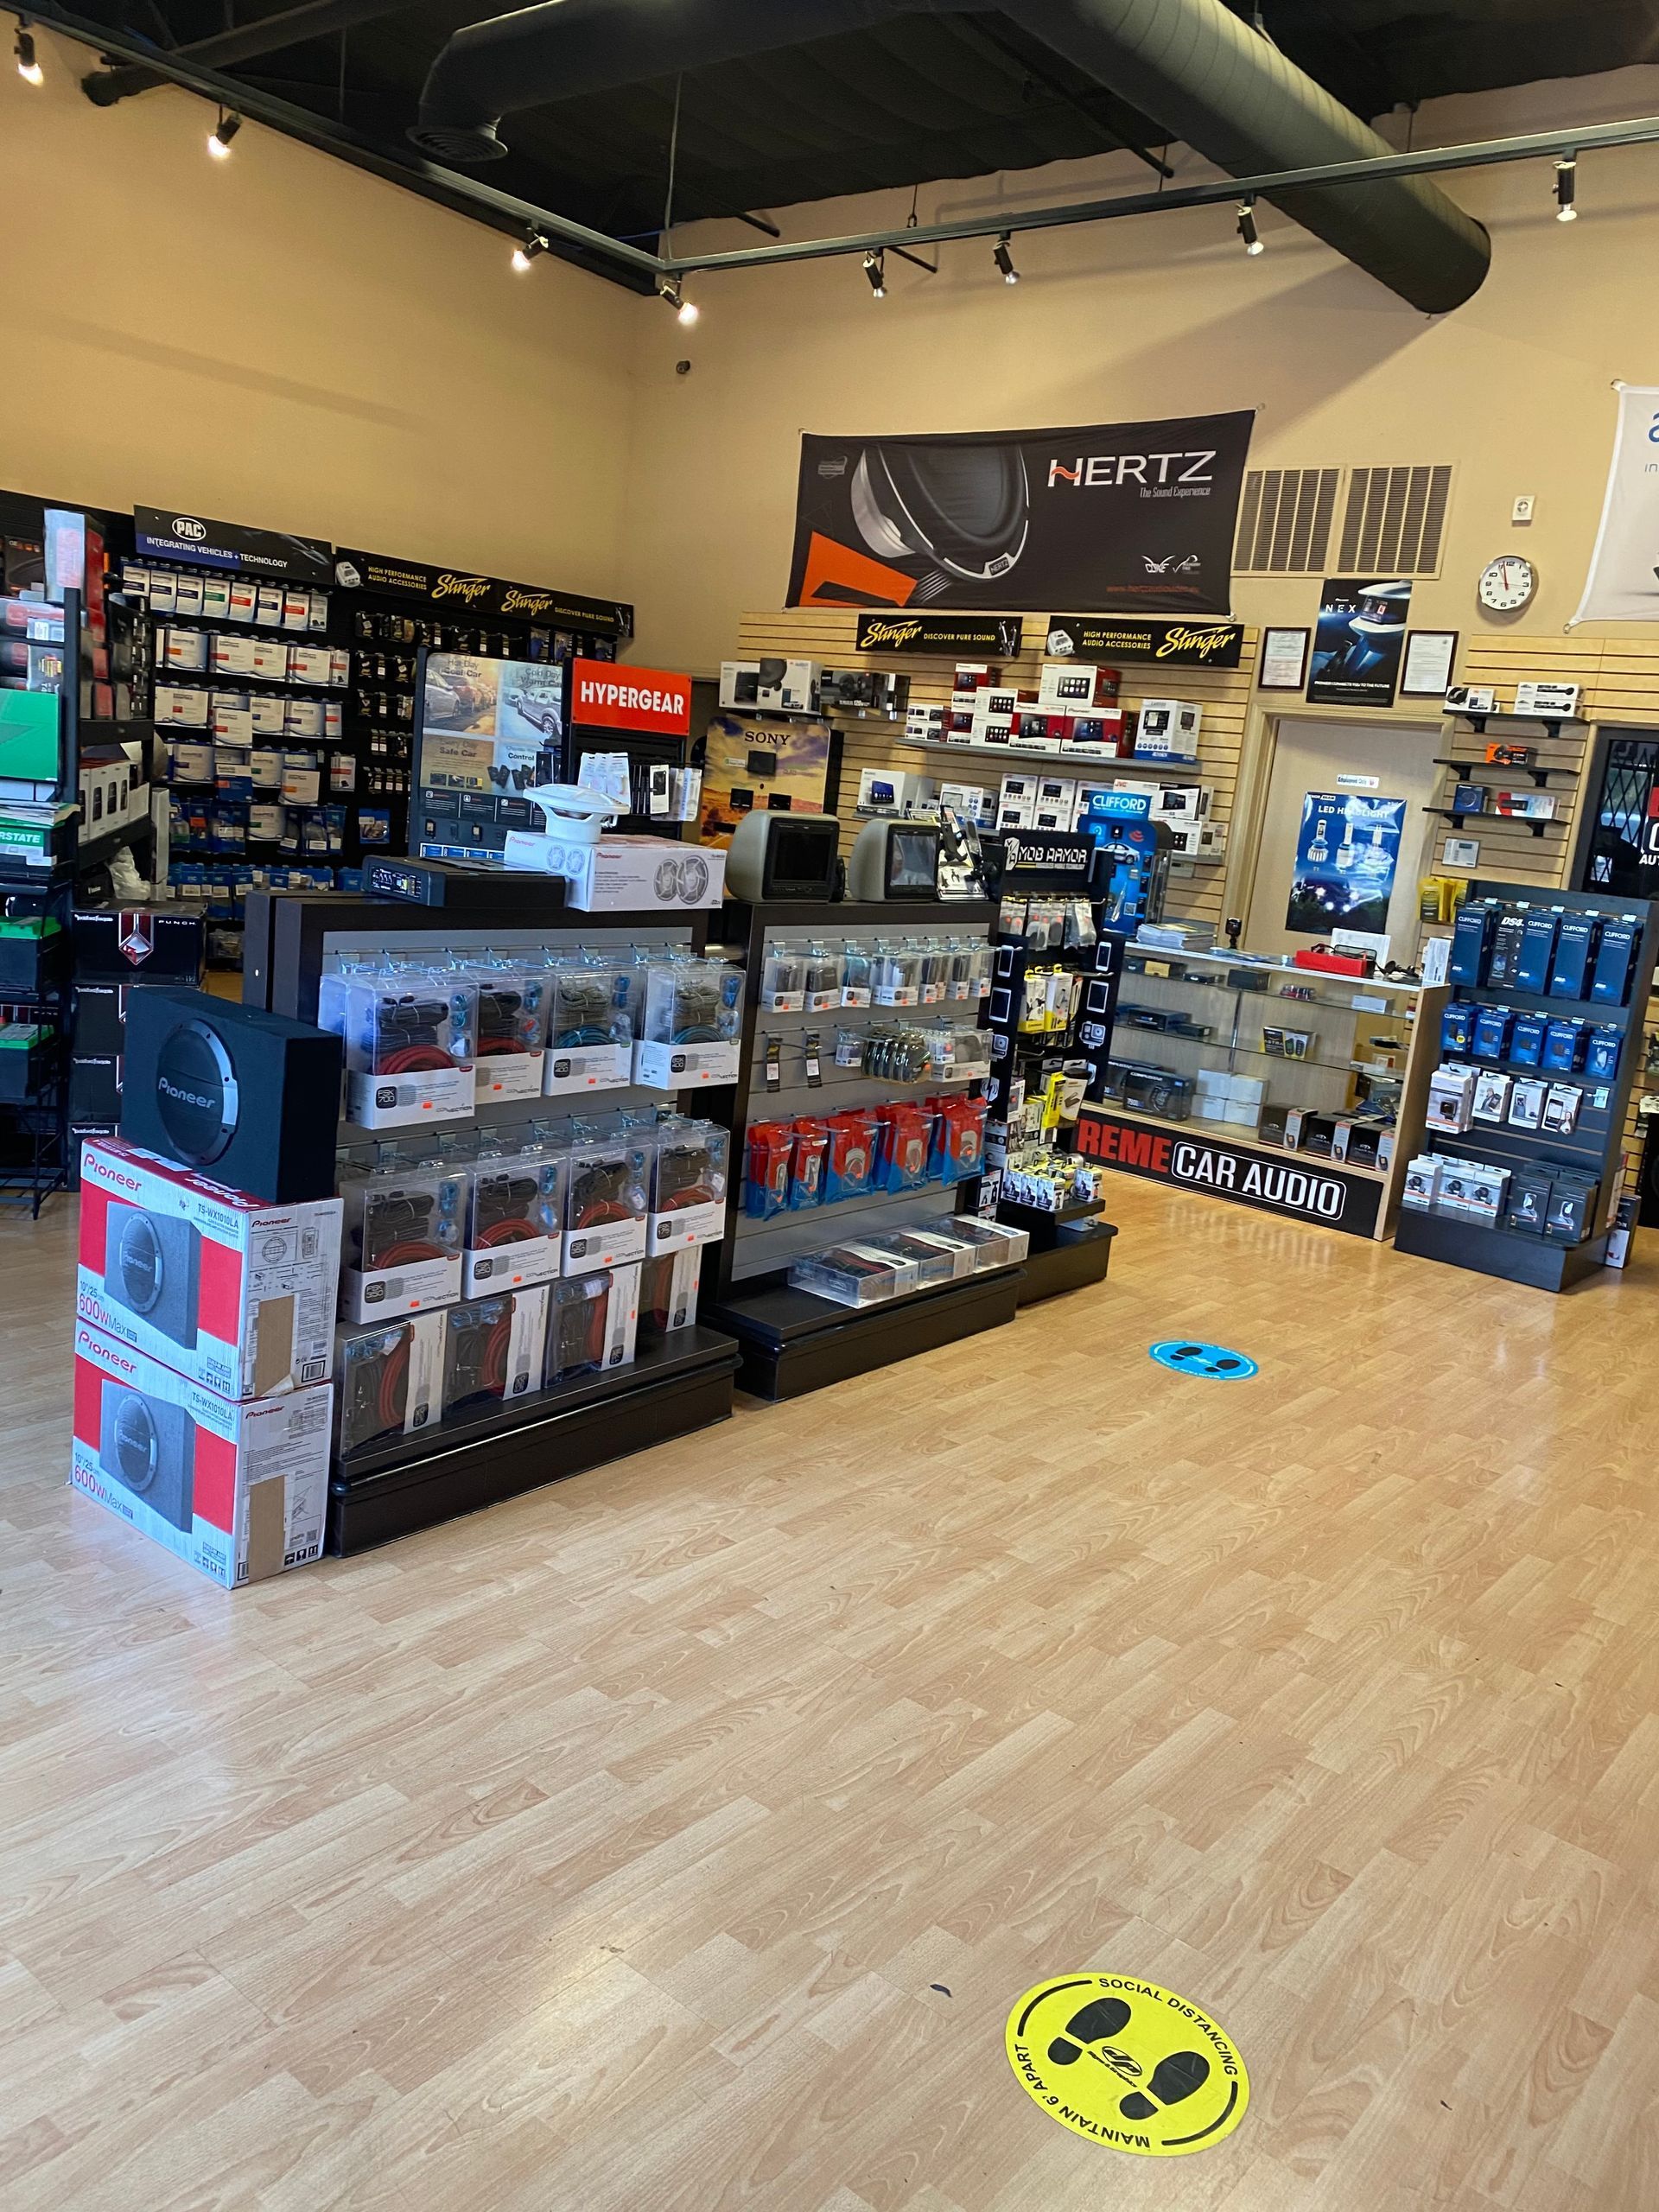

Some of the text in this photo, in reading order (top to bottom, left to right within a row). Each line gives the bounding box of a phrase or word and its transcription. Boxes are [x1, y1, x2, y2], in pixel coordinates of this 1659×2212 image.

[1047, 450, 1217, 487] HERTZ
[1140, 485, 1211, 498] The Sound Experience
[177, 521, 202, 537] PAC
[147, 537, 196, 552] INTEGRATING
[197, 545, 233, 559] VEHICLES
[239, 553, 288, 568] TECHNOLOGY
[368, 566, 427, 582] HIGH PERFORMANCE
[368, 574, 427, 590] AUDIO ACCESSORIES
[431, 574, 491, 603] Stinger
[500, 589, 553, 616] Stinger
[1325, 604, 1357, 613] NEX
[860, 620, 923, 648] Stinger
[924, 632, 955, 641] DISCOVER
[1084, 630, 1152, 641] HIGH PERFORMANCE
[1155, 626, 1236, 658] Stinger
[1082, 639, 1151, 650] AUDIO ACCESSORIES
[466, 669, 482, 678] Car
[545, 668, 561, 679] Day
[581, 681, 683, 715] HYPERGEAR
[744, 731, 791, 746] SONY
[439, 747, 477, 758] Safe Car
[508, 752, 535, 761] Control
[1092, 794, 1147, 811] CLIFFORD
[1318, 804, 1335, 814] LED
[1019, 846, 1087, 863] MOB ARMOR
[1458, 916, 1482, 925] CLIFFORD
[1528, 919, 1553, 930] CLIFFORD
[1562, 925, 1588, 933] CLIFFORD
[1605, 931, 1630, 940] CLIFFORD
[1479, 1018, 1502, 1027] CLIFFORD
[1517, 1026, 1540, 1035] CLIFFORD
[1592, 1039, 1616, 1048] CLIFFORD
[158, 1077, 216, 1109] Pioneer
[378, 1095, 395, 1103] 700
[83, 1153, 142, 1193] Pioneer
[1074, 1117, 1340, 1217] REME CAR AUDIO
[198, 1203, 239, 1230] TS-WX1010LA
[251, 1217, 292, 1229] Pioneer
[78, 1330, 137, 1374] Pioneer
[192, 1392, 233, 1421] TS-WX1010LA
[245, 1406, 285, 1420] Pioneer
[1099, 1977, 1164, 2002] SOCIAL
[1167, 1997, 1238, 2076] DISTANCING
[1014, 2044, 1048, 2091] APART
[1058, 2106, 1151, 2149] MAINTAIN
